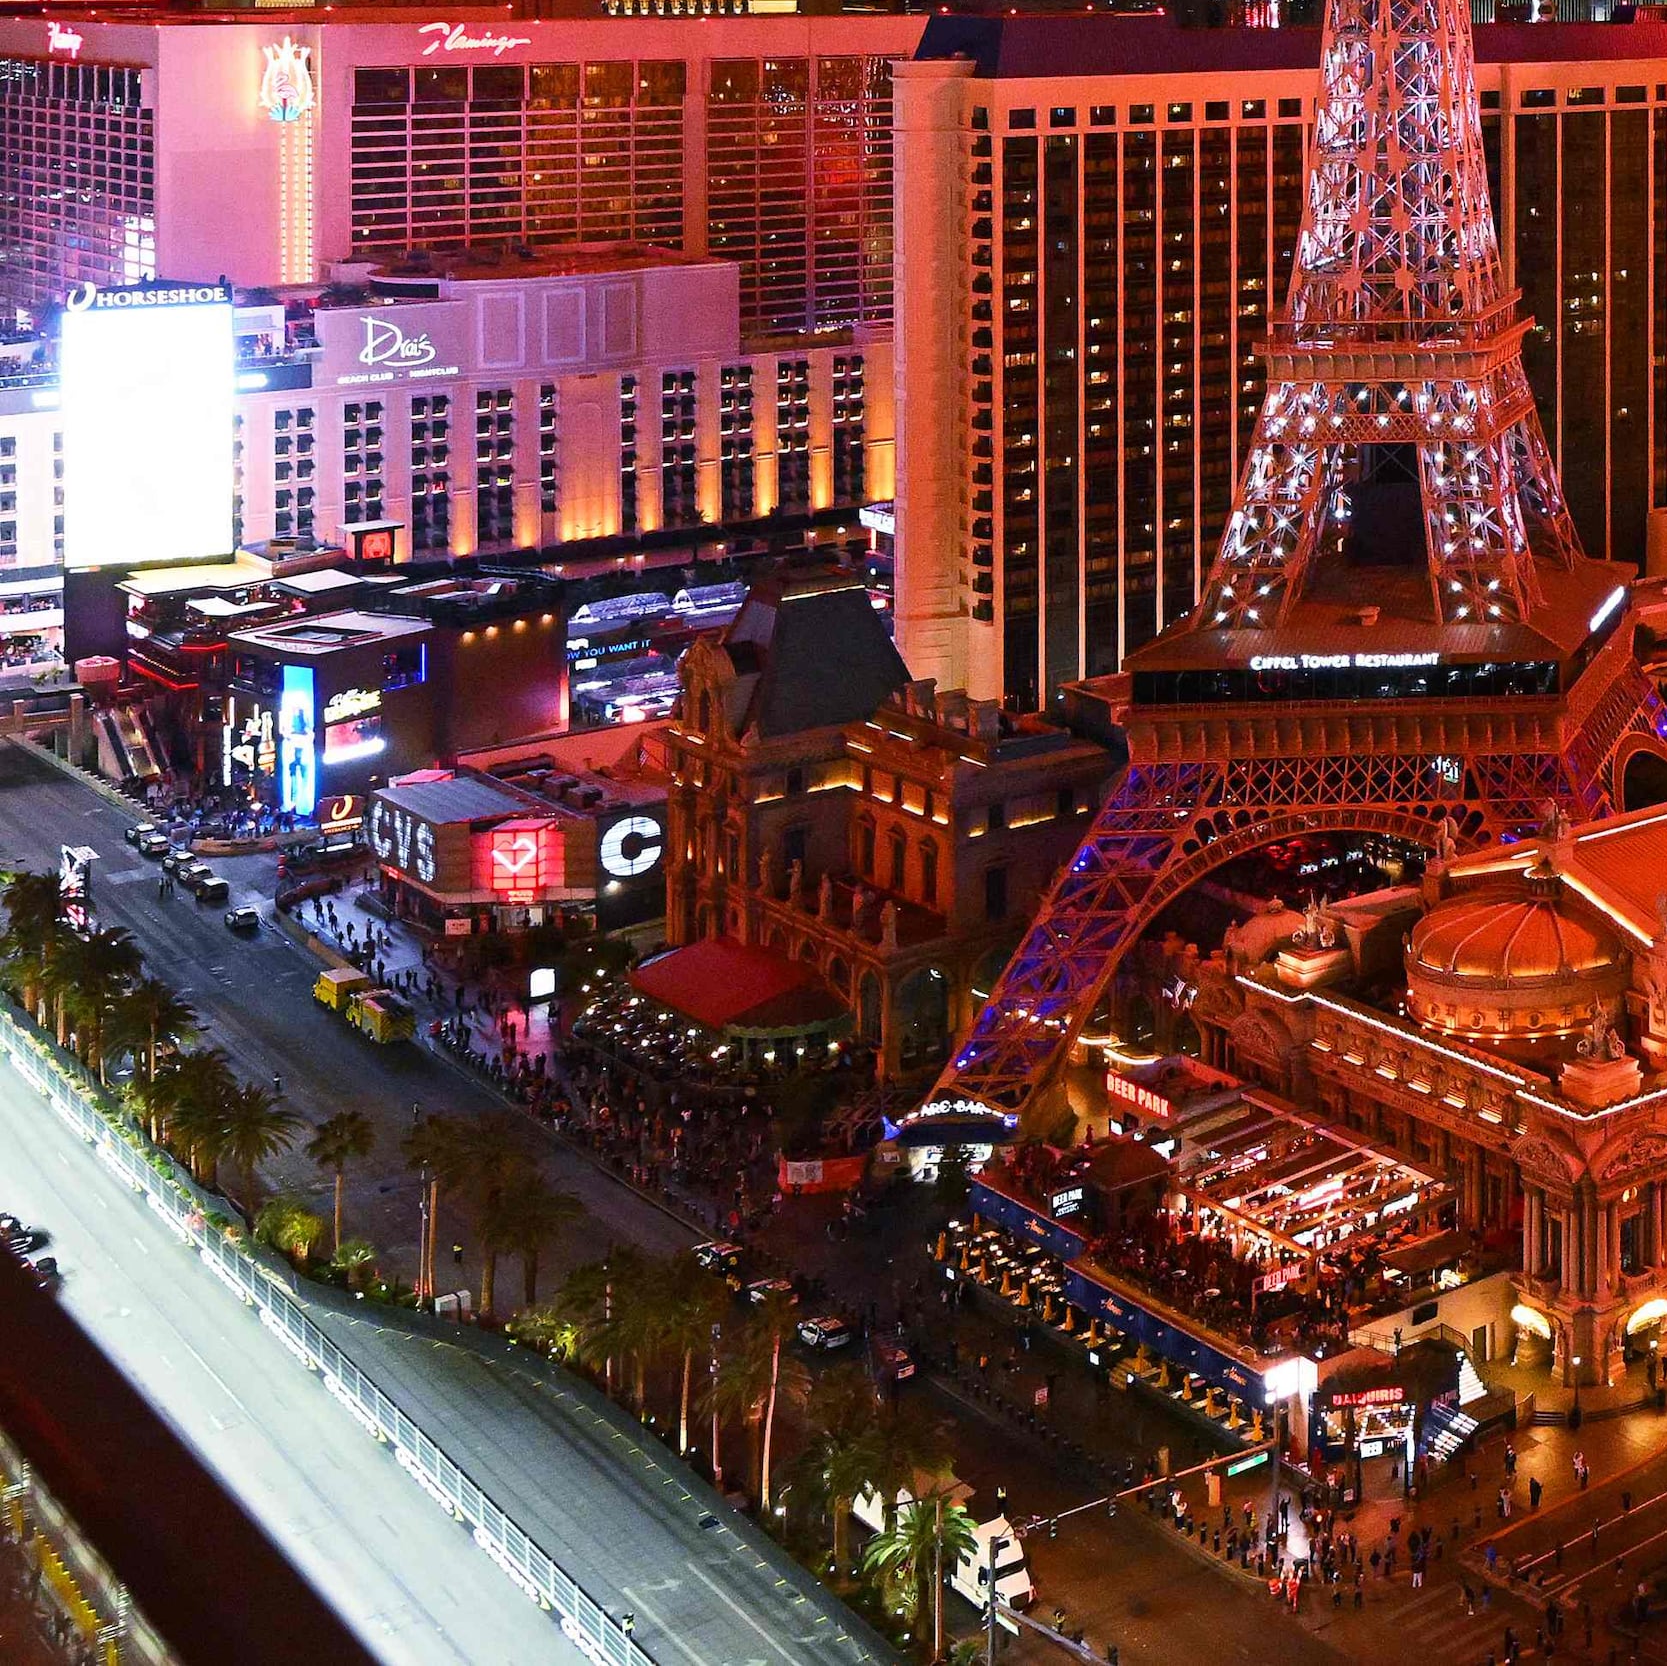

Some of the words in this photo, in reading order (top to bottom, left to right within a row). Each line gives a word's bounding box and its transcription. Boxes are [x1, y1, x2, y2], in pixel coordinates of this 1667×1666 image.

[418, 22, 532, 56] Flamingo
[97, 286, 229, 308] HORSESHOE
[359, 316, 437, 367] Drai's
[609, 640, 638, 654] WANT
[641, 639, 652, 649] IT
[1250, 656, 1299, 671] EIFFEL
[1301, 654, 1350, 668] TOWER
[1355, 652, 1440, 667] RESTAURANT
[372, 800, 436, 882] CVS
[1106, 1073, 1136, 1105] BEER
[1137, 1087, 1170, 1118] PARK
